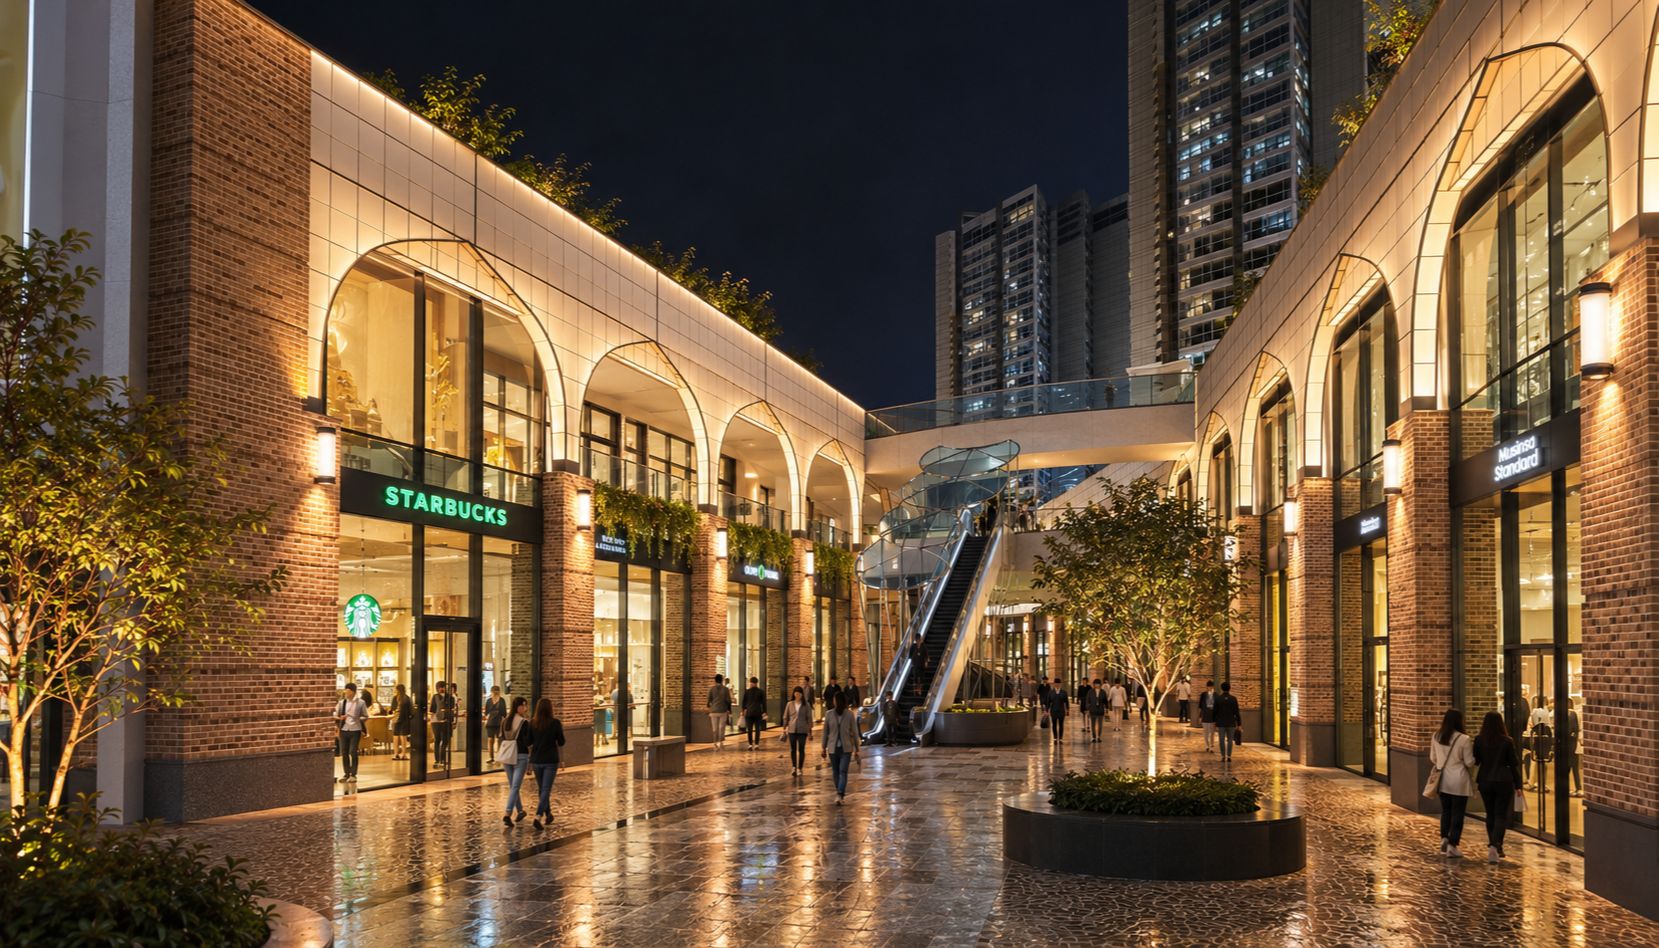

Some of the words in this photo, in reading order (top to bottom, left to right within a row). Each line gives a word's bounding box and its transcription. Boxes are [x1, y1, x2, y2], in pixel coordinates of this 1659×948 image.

[1494, 447, 1538, 482] Standard
[1498, 435, 1535, 463] Musinsa
[385, 486, 508, 526] STARBUCKS
